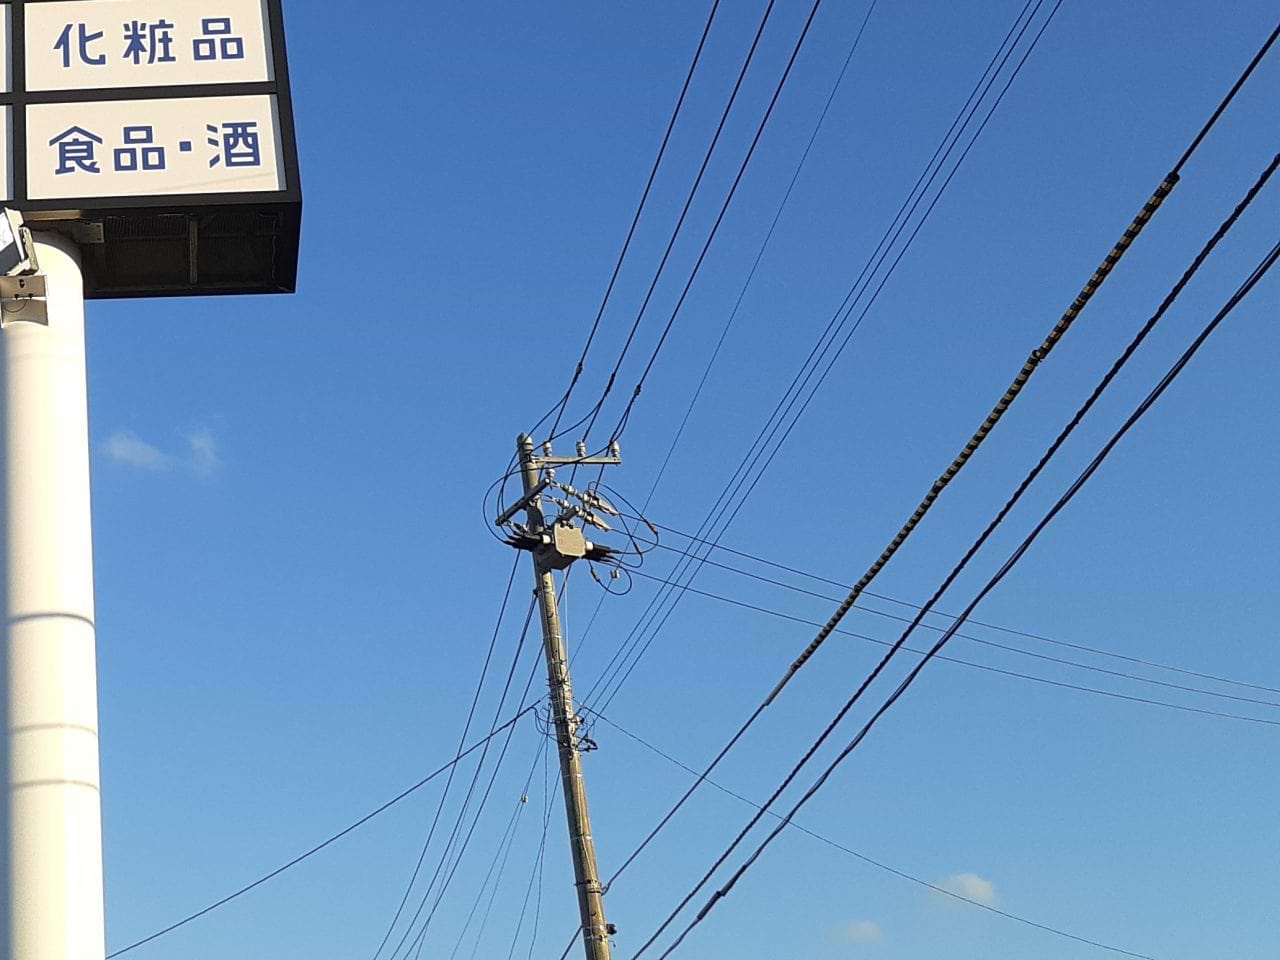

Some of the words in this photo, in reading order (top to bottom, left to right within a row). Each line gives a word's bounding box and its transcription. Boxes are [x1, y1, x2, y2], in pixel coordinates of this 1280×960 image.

[53, 17, 245, 68] 化粧品
[49, 121, 261, 176] 食品・酒
